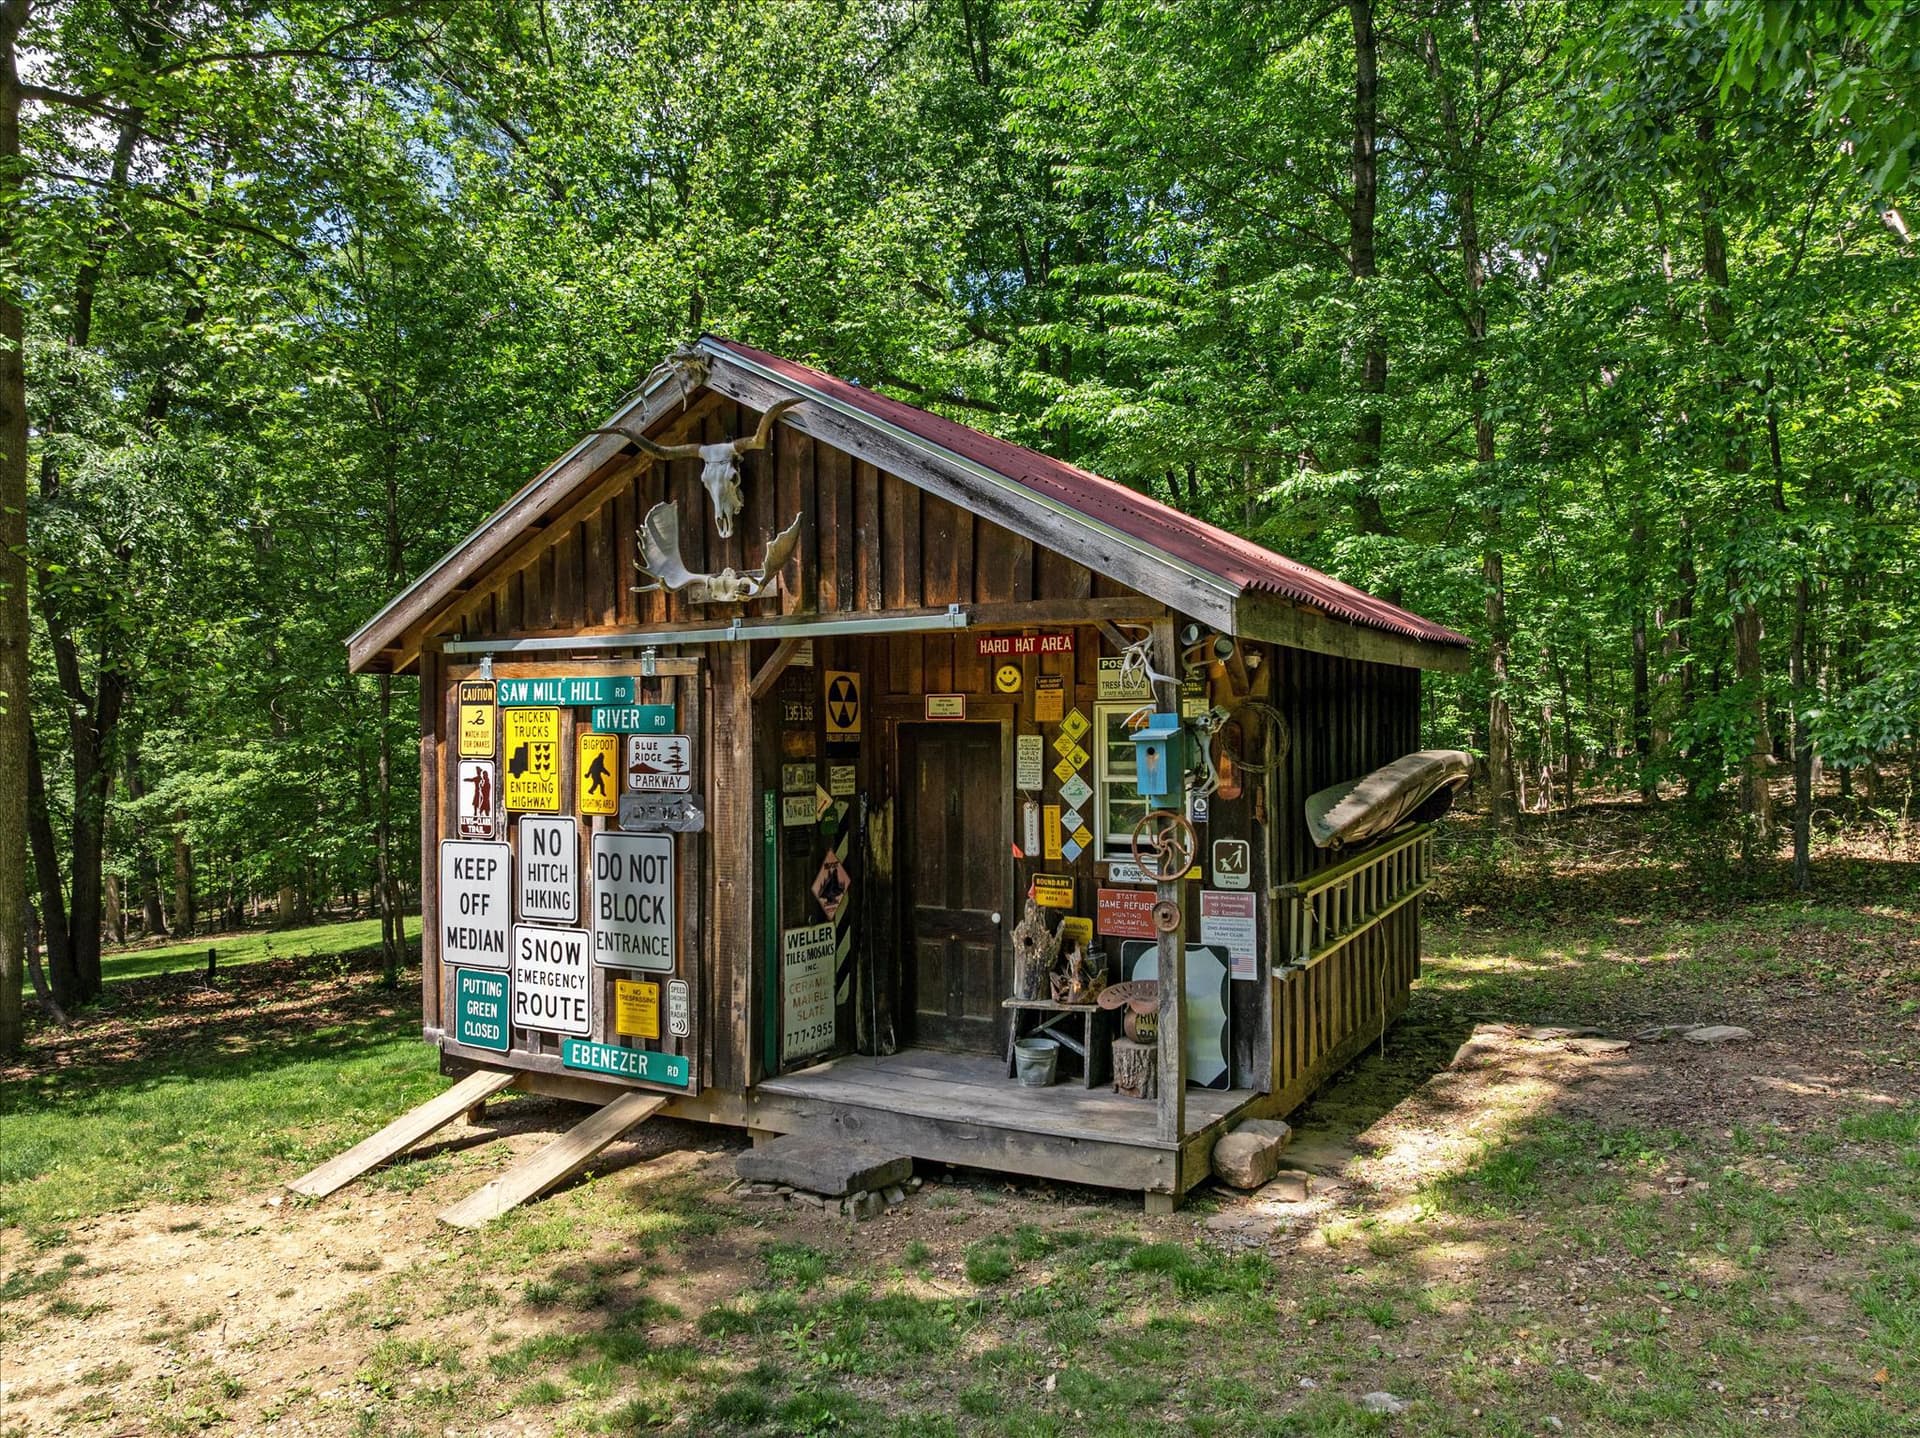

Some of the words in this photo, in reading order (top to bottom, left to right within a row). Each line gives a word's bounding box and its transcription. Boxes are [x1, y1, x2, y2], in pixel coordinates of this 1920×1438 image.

[980, 640, 1009, 653] HARD
[1015, 638, 1036, 652] HAT
[1041, 636, 1072, 651] AREA
[462, 687, 493, 702] CAUTION
[501, 682, 527, 701] SAW
[533, 682, 565, 701] MILL
[571, 681, 603, 701] HILL
[615, 687, 626, 698] RD
[512, 712, 551, 723] CHICKEN
[596, 709, 640, 729] RIVER
[654, 715, 666, 727] RD
[514, 725, 549, 738] TRUCKS
[583, 738, 614, 751] BIGFOOT
[635, 741, 658, 750] BLUE
[635, 752, 662, 762] RIDGE
[510, 781, 554, 794] ENTERING
[635, 775, 682, 788] PARKWAY
[512, 796, 552, 809] HIGHWAY
[533, 828, 562, 856] NO
[454, 857, 497, 881] KEEP
[528, 863, 568, 883] HITCH
[597, 852, 622, 881] DO
[629, 854, 668, 885] NOT
[1036, 878, 1069, 887] BOUNDARY
[460, 893, 490, 916] OFF
[525, 889, 571, 910] HIKING
[600, 892, 665, 925] BLOCK
[1099, 899, 1120, 909] GAME
[1124, 901, 1155, 911] REFUGE
[447, 926, 504, 953] MEDIAN
[596, 931, 670, 957] ENTRANCE
[787, 927, 833, 949] WELLER
[522, 937, 581, 966] SNOW
[786, 951, 800, 966] TILE
[807, 943, 835, 960] MOSAICS
[463, 978, 502, 998] PUTTING
[517, 968, 585, 990] EMERGENCY
[670, 985, 686, 994] SPEED
[467, 1000, 498, 1018] GREEN
[517, 991, 586, 1022] ROUTE
[797, 1004, 825, 1021] SLATE
[464, 1020, 500, 1040] CLOSED
[572, 1043, 648, 1075] EBENEZER
[667, 1065, 679, 1077] RD
